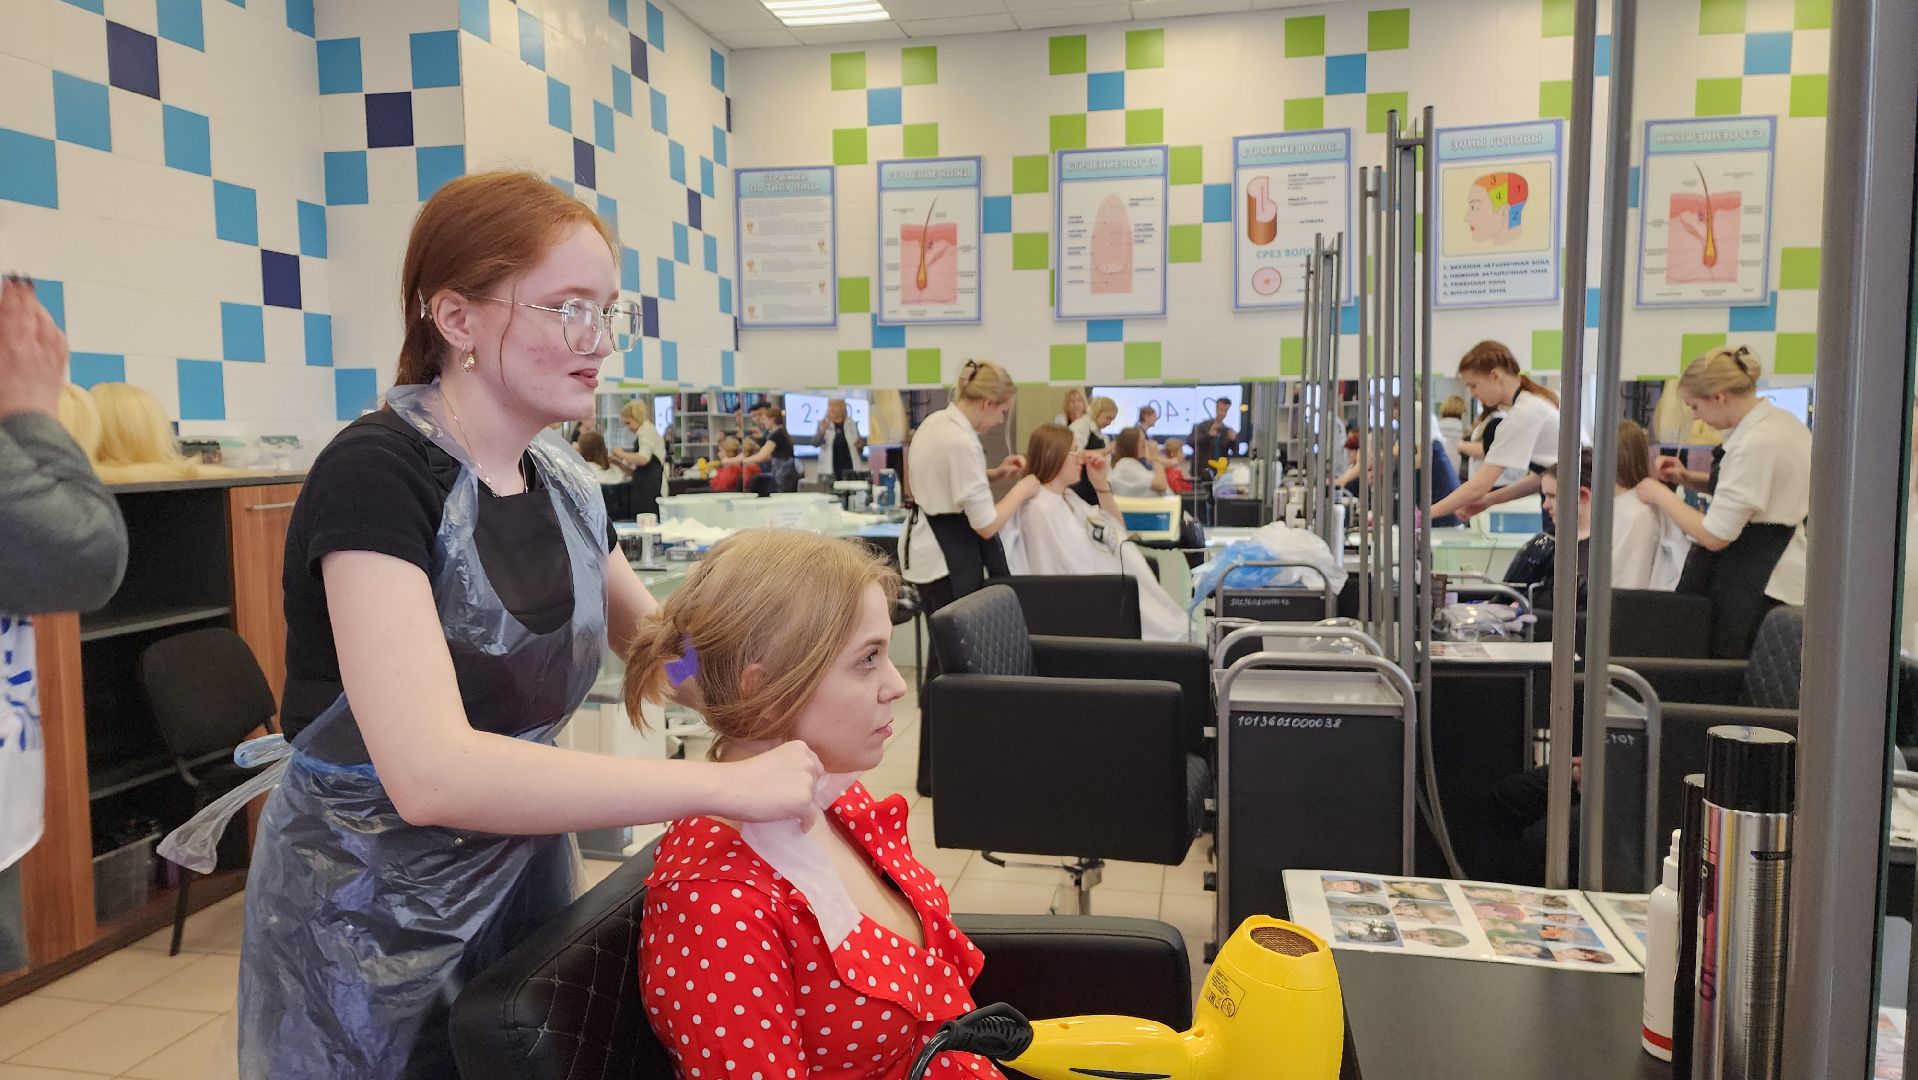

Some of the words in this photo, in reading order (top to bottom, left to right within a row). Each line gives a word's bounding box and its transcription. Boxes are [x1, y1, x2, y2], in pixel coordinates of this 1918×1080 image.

[1451, 138, 1487, 152] ЗОНЫ
[1489, 132, 1543, 147] ГОЛОВЫ
[1240, 143, 1296, 158] СТРОЕНИЕ
[1297, 141, 1342, 154] ВОЛОСА
[1065, 159, 1121, 171] СТРОЕНИЕ
[886, 168, 938, 180] СТРОЕНИЕ
[940, 167, 970, 179] КОЖИ
[1489, 175, 1497, 185] 3
[748, 184, 764, 193] ПО
[766, 183, 792, 192] ТИПУ
[793, 182, 821, 193] ЛИЦА
[1495, 192, 1501, 201] 4
[1511, 210, 1519, 220] 2
[1256, 248, 1281, 259] СРЕЗ
[1285, 247, 1313, 257] ВОЛО
